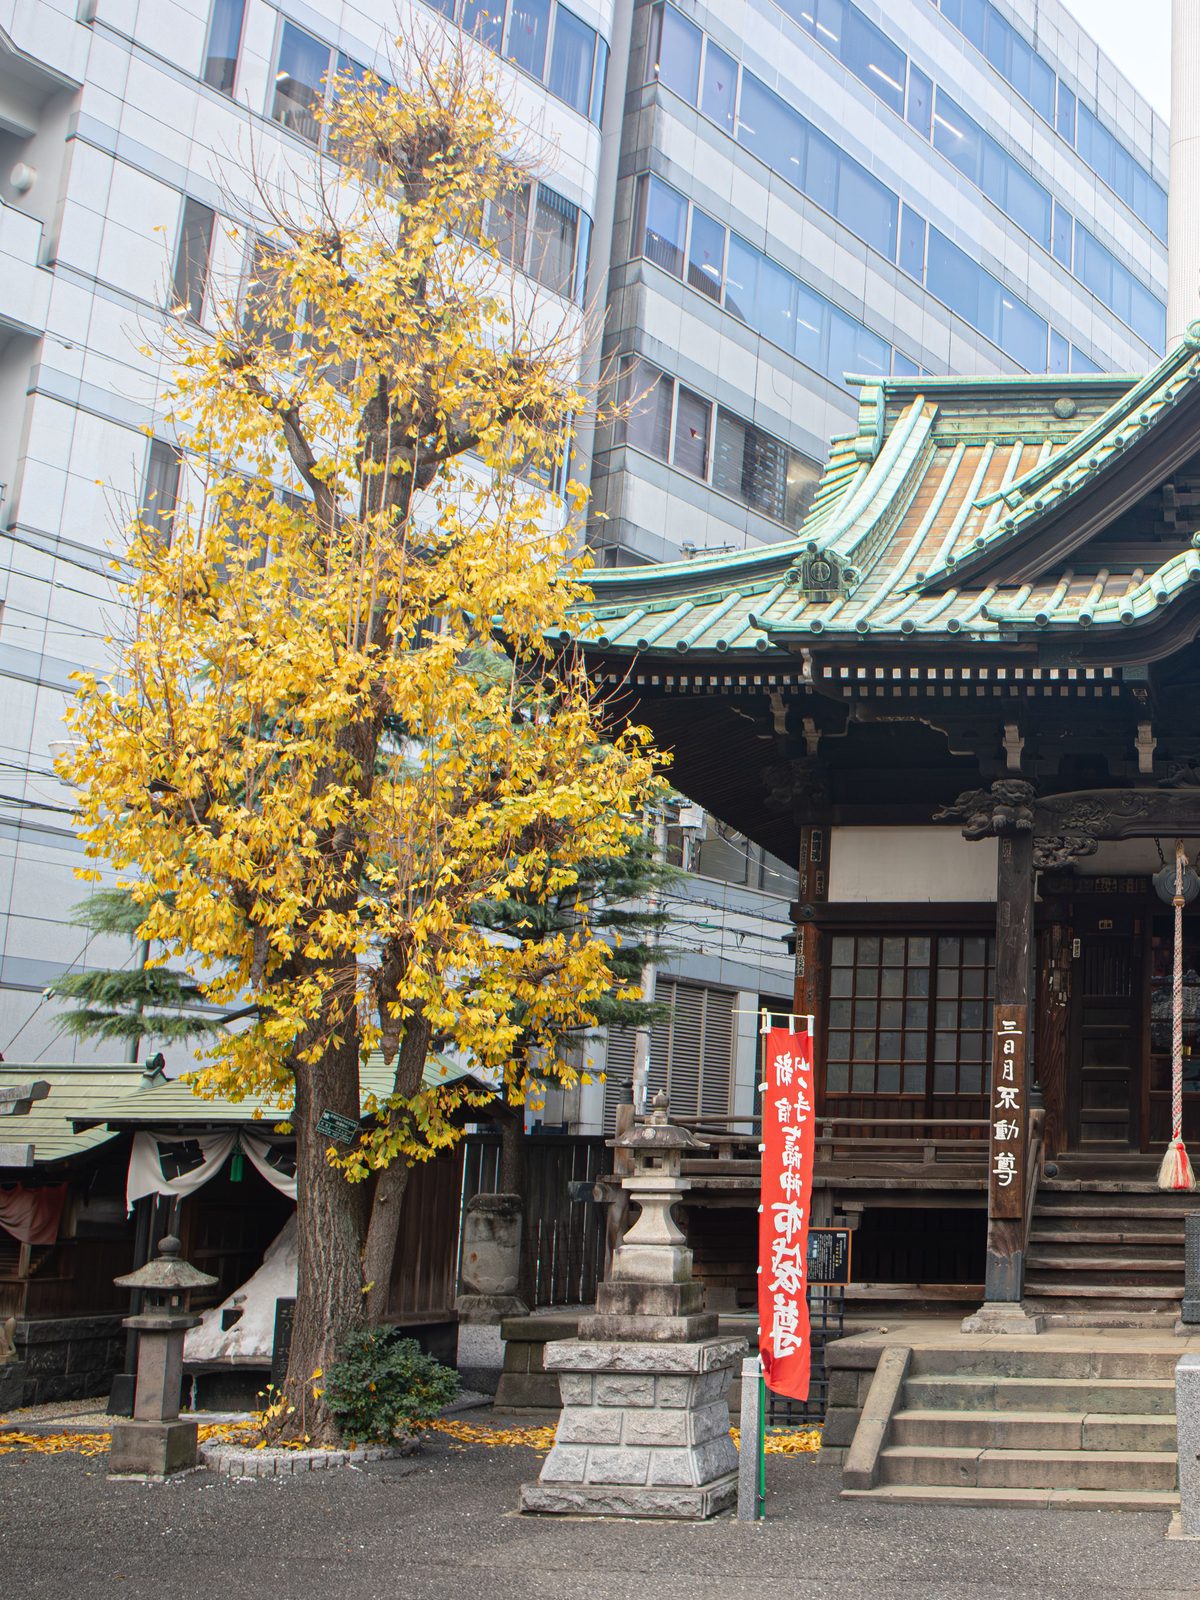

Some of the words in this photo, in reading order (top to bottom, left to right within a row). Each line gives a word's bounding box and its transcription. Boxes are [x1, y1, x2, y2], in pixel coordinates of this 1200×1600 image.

[993, 1020, 1023, 1187] 三日月不動尊
